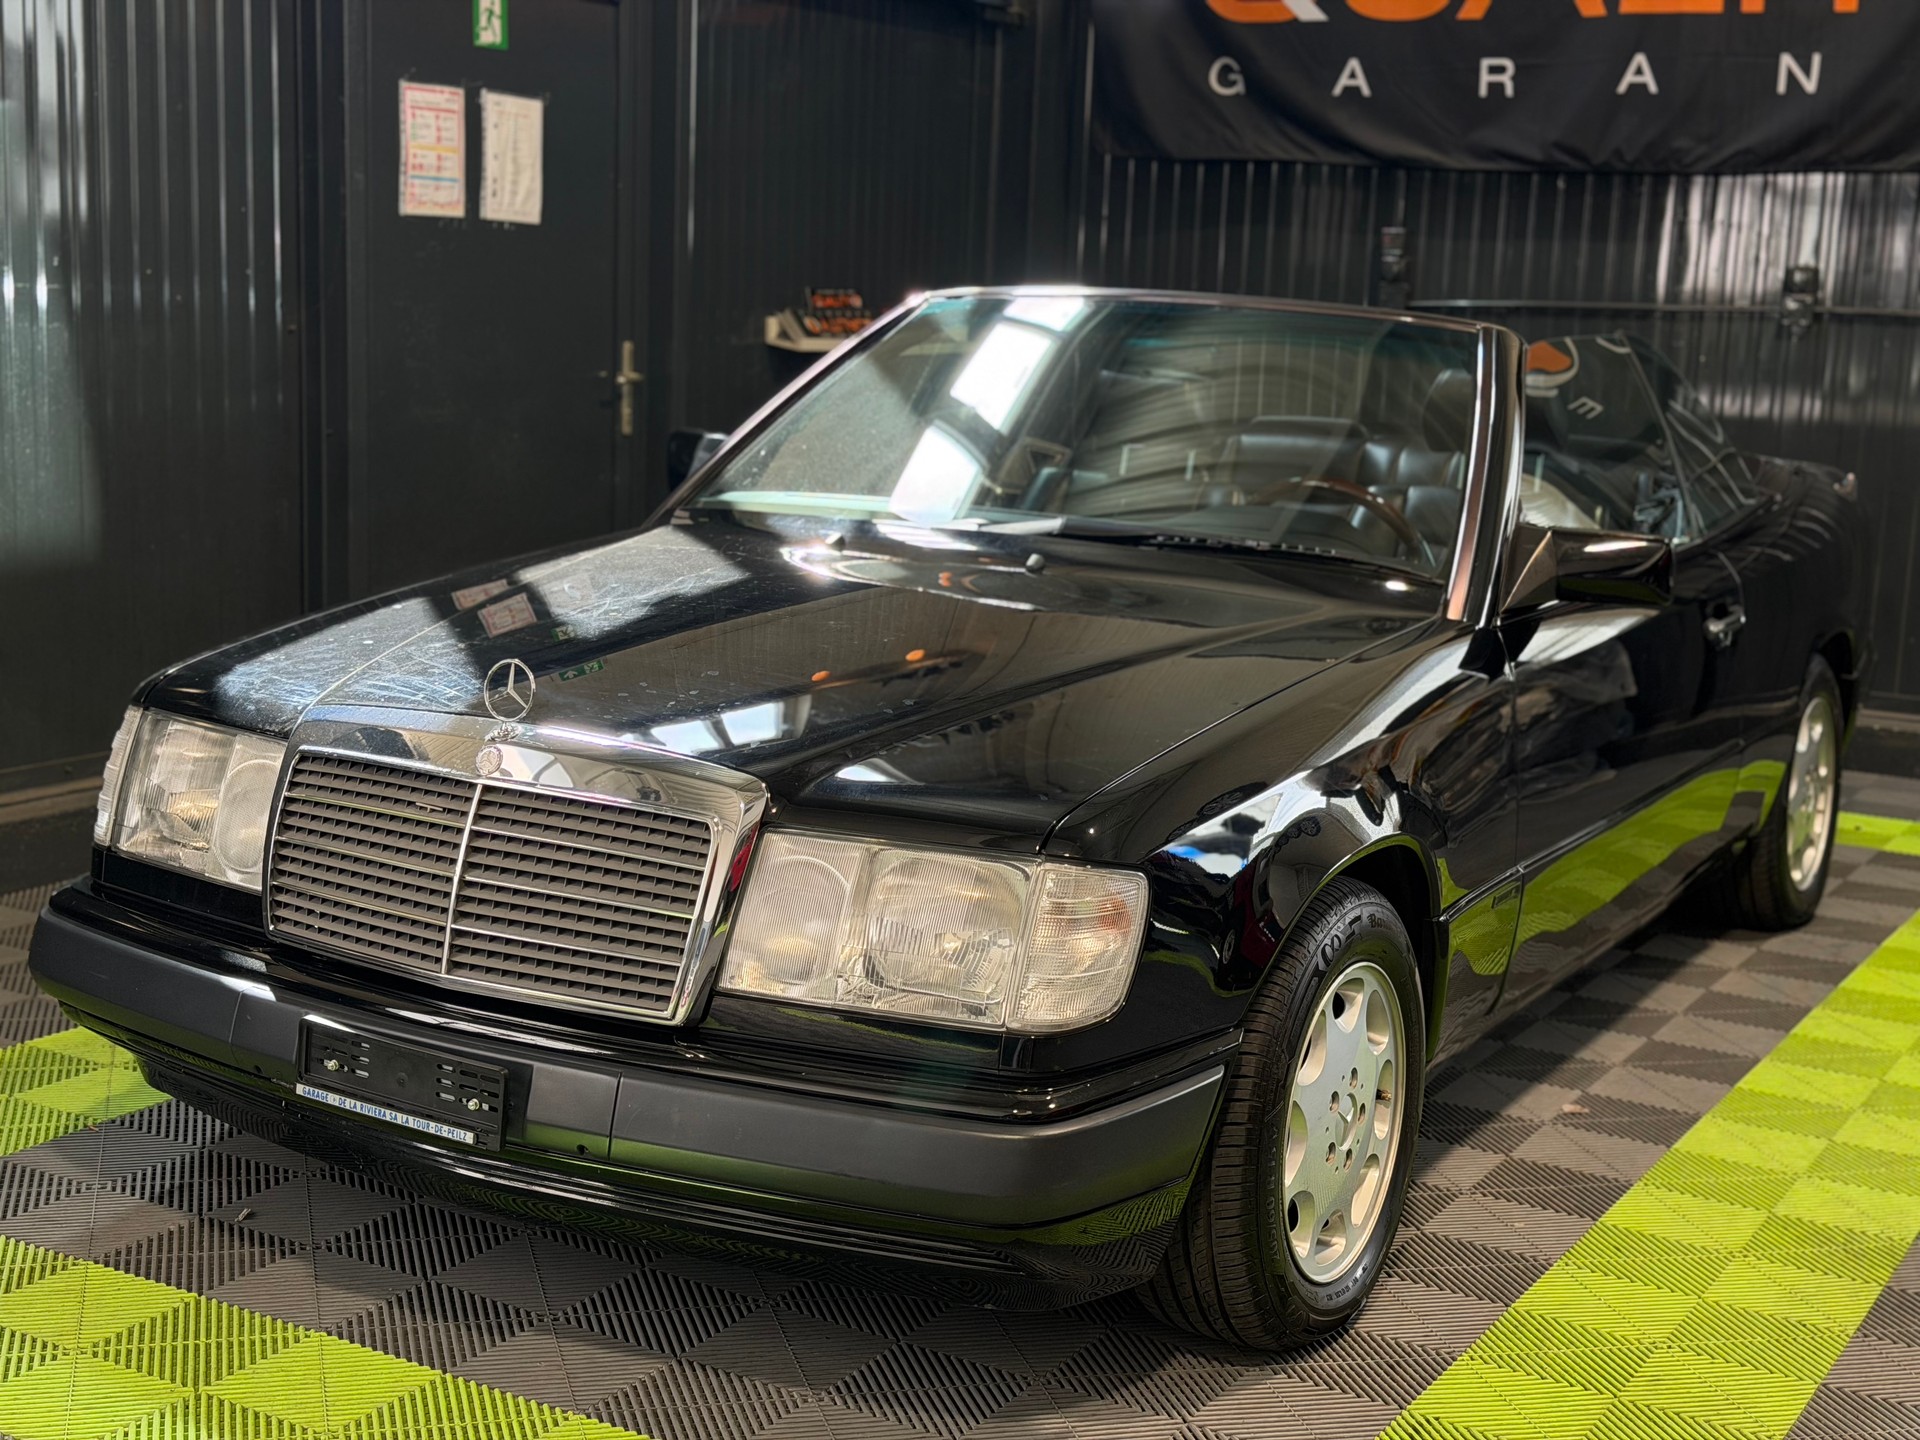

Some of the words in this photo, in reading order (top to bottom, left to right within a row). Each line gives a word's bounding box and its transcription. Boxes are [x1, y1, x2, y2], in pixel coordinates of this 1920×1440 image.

[302, 1087, 330, 1103] GARAGE
[338, 1097, 347, 1108] DE
[349, 1101, 358, 1112] LA
[360, 1103, 387, 1119] RIVIERA
[389, 1112, 398, 1123] SA
[401, 1115, 410, 1126] LA
[412, 1118, 468, 1141] TOUR-DE-PEILZ
